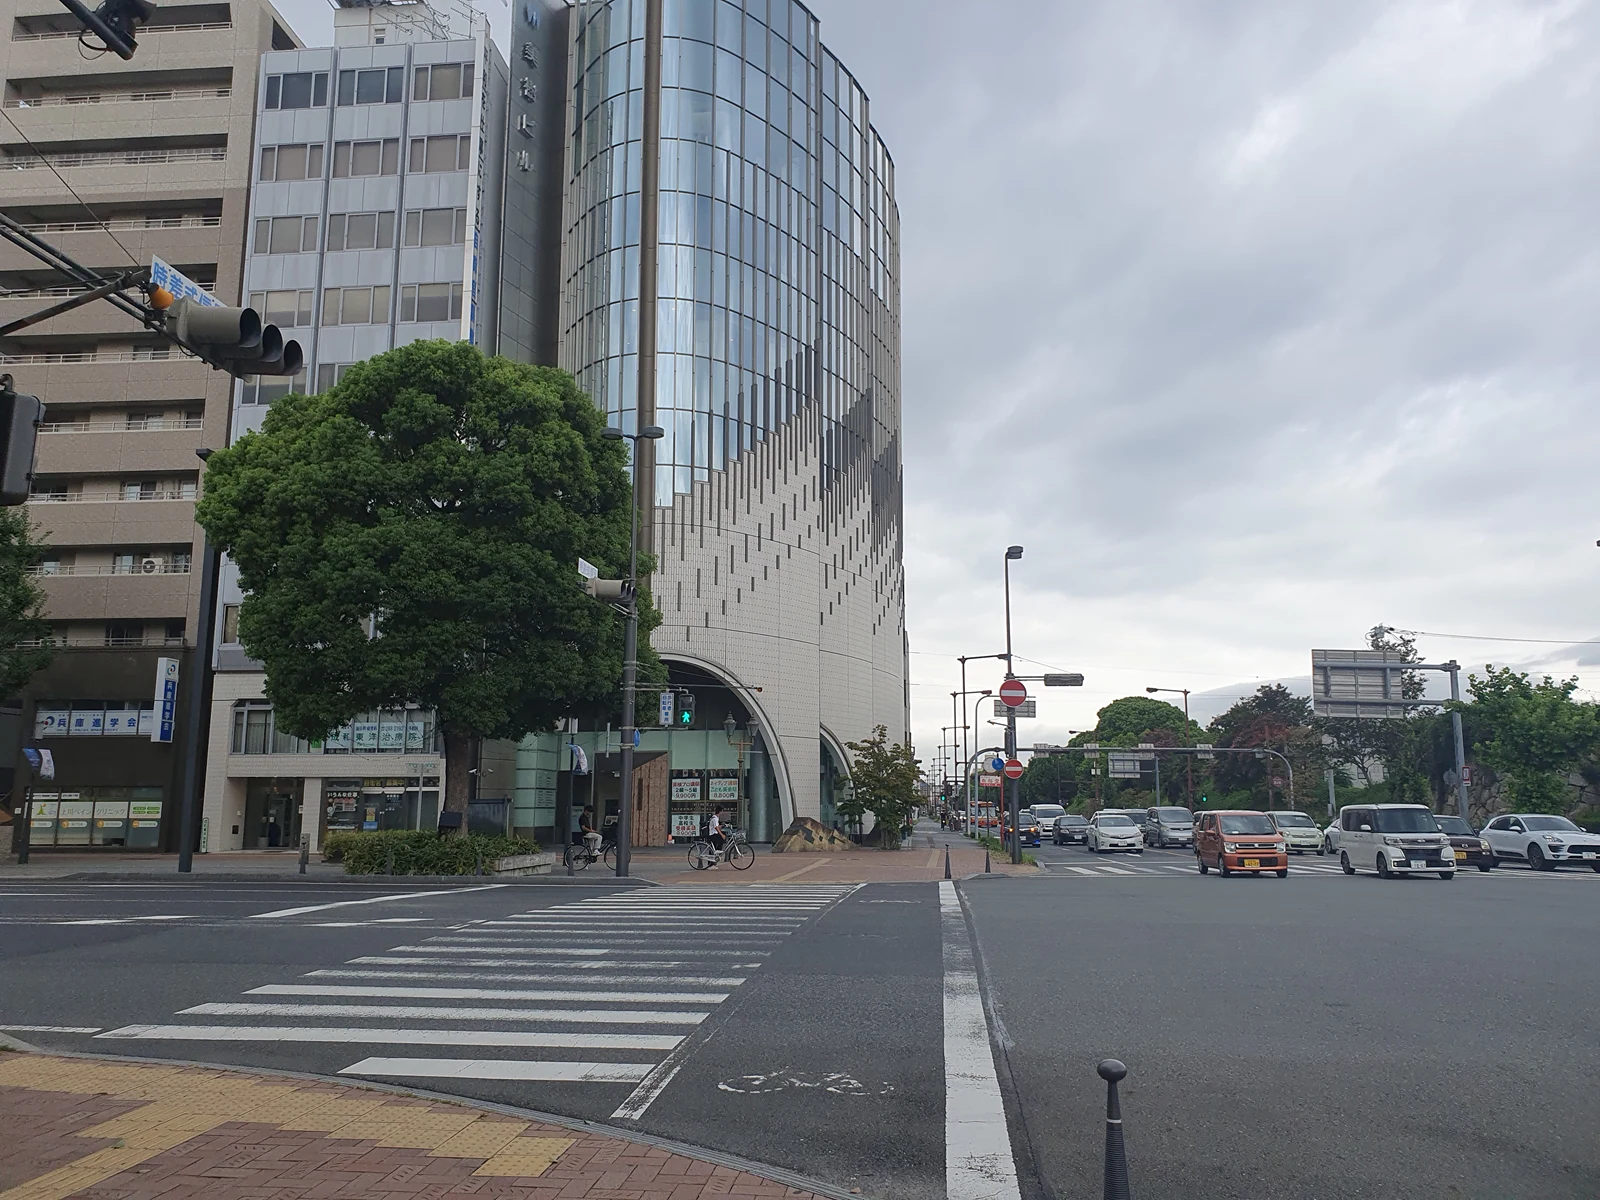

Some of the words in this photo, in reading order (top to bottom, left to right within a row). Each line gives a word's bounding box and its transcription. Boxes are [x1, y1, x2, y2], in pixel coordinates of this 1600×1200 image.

[153, 261, 221, 307] 時差式信
[57, 717, 137, 728] 兵庫進学会
[164, 682, 173, 731] 兵庫進学会
